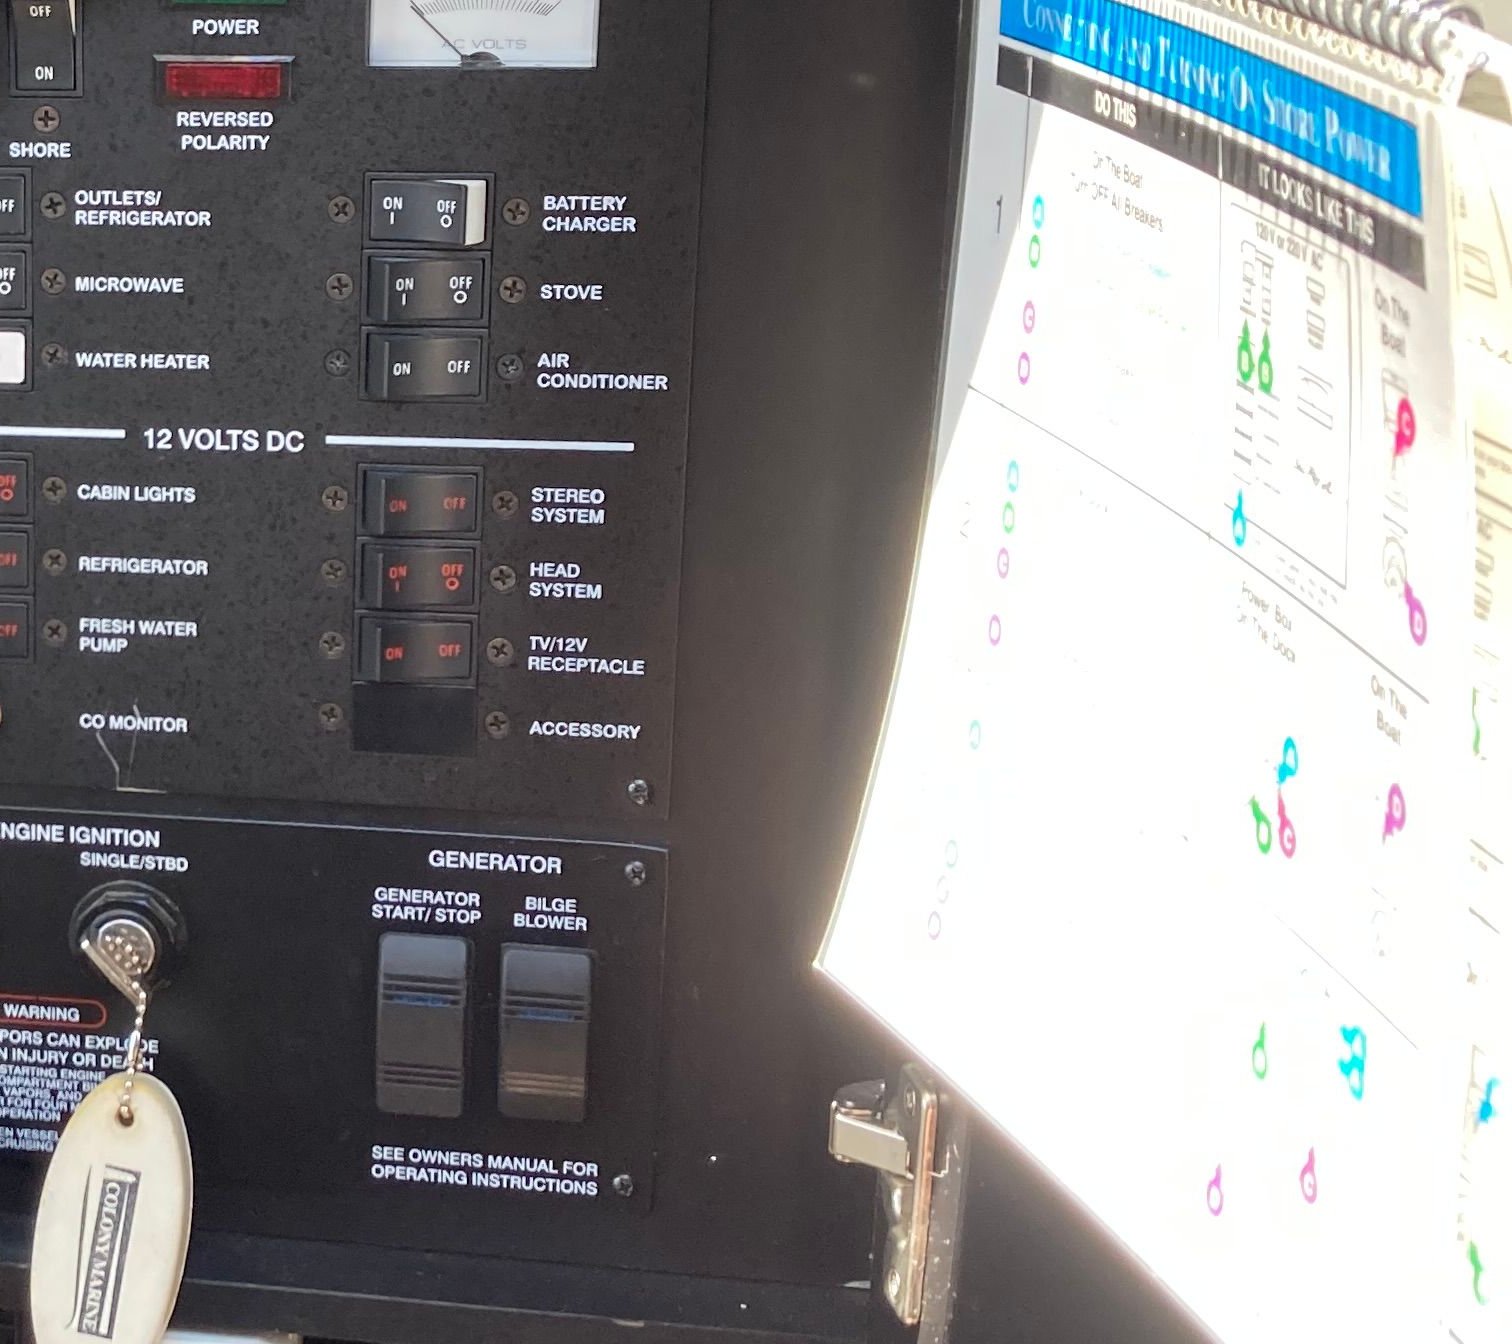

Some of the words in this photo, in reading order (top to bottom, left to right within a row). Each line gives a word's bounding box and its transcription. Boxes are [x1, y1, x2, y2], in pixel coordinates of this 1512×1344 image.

[29, 5, 51, 18] OFF
[192, 19, 259, 35] POWER
[471, 38, 527, 50] VOLTS
[35, 67, 54, 80] ON
[1095, 90, 1111, 116] DO
[1113, 97, 1136, 128] THIS
[176, 111, 274, 128] REVERSED
[9, 142, 72, 158] SHORE
[180, 134, 270, 152] POLARITY
[75, 190, 162, 206] OUTLETS/
[383, 197, 403, 210] ON
[437, 200, 457, 214] OFF
[543, 196, 627, 211] BATTERY
[1258, 162, 1270, 190] IT
[1273, 168, 1313, 210] LOOKS
[1316, 191, 1343, 228] LIKE
[1346, 205, 1375, 246] THIS
[75, 210, 211, 227] REFRIGERATOR
[996, 194, 1003, 234] 1
[542, 217, 636, 232] CHARGER
[1256, 221, 1268, 241] 120
[1287, 238, 1300, 259] 220
[1311, 250, 1323, 271] AC
[75, 277, 184, 293] MICROWAVE
[396, 278, 414, 291] ON
[449, 277, 472, 290] OFF
[540, 285, 603, 301] STOVE
[1375, 288, 1389, 315] On
[1390, 296, 1410, 326] The
[75, 353, 137, 369] WATER
[140, 354, 210, 370] HEATER
[393, 362, 411, 376] ON
[447, 361, 471, 374] OFF
[538, 354, 569, 368] AIR
[537, 374, 668, 390] CONDITIONER
[143, 428, 171, 450] 12
[178, 428, 260, 451] VOLTS
[266, 430, 305, 453] DC
[77, 485, 130, 501] CABIN
[134, 487, 196, 503] LIGHTS
[531, 488, 605, 504] STEREO
[389, 500, 406, 512] ON
[443, 497, 467, 510] OFF
[531, 507, 605, 524] SYSTEM
[79, 556, 208, 575] REFRIGERATOR
[389, 566, 406, 579] ON
[441, 563, 464, 577] OFF
[530, 562, 580, 578] HEAD
[529, 583, 603, 599] SYSTEM
[79, 618, 135, 635] FRESH
[138, 621, 198, 636] WATER
[79, 638, 128, 653] PUMP
[530, 636, 588, 652] TV/12V
[386, 647, 403, 660] ON
[528, 656, 645, 675] RECEPTACLE
[1370, 674, 1386, 699] On
[1388, 686, 1408, 719] The
[79, 714, 105, 729] CO
[108, 715, 188, 733] MONITOR
[529, 721, 641, 739] ACCESSORY
[69, 826, 161, 848] IGNITION
[80, 852, 189, 872] SINGLE/STBD
[428, 850, 563, 874] GENERATOR
[374, 887, 480, 907] GENERATOR
[525, 897, 577, 913] BILGE
[372, 904, 431, 922] START/
[435, 907, 482, 924] STOP
[513, 913, 587, 931] BLOWER
[3, 1003, 80, 1022] WARNING
[46, 1033, 81, 1048] CAN
[84, 1036, 159, 1054] EXPLDE
[11, 1047, 70, 1065] INJURY
[72, 1052, 96, 1067] OR
[0, 1065, 58, 1079] STARTING
[372, 1145, 405, 1163] SEE
[408, 1148, 484, 1168] OWNERS
[487, 1155, 559, 1173] MANUAL
[563, 1161, 598, 1177] FOR
[371, 1164, 467, 1186] OPERATING
[472, 1173, 598, 1196] INSTRUCTIONS
[95, 1182, 120, 1256] COLONY
[82, 1257, 107, 1333] MARINE
